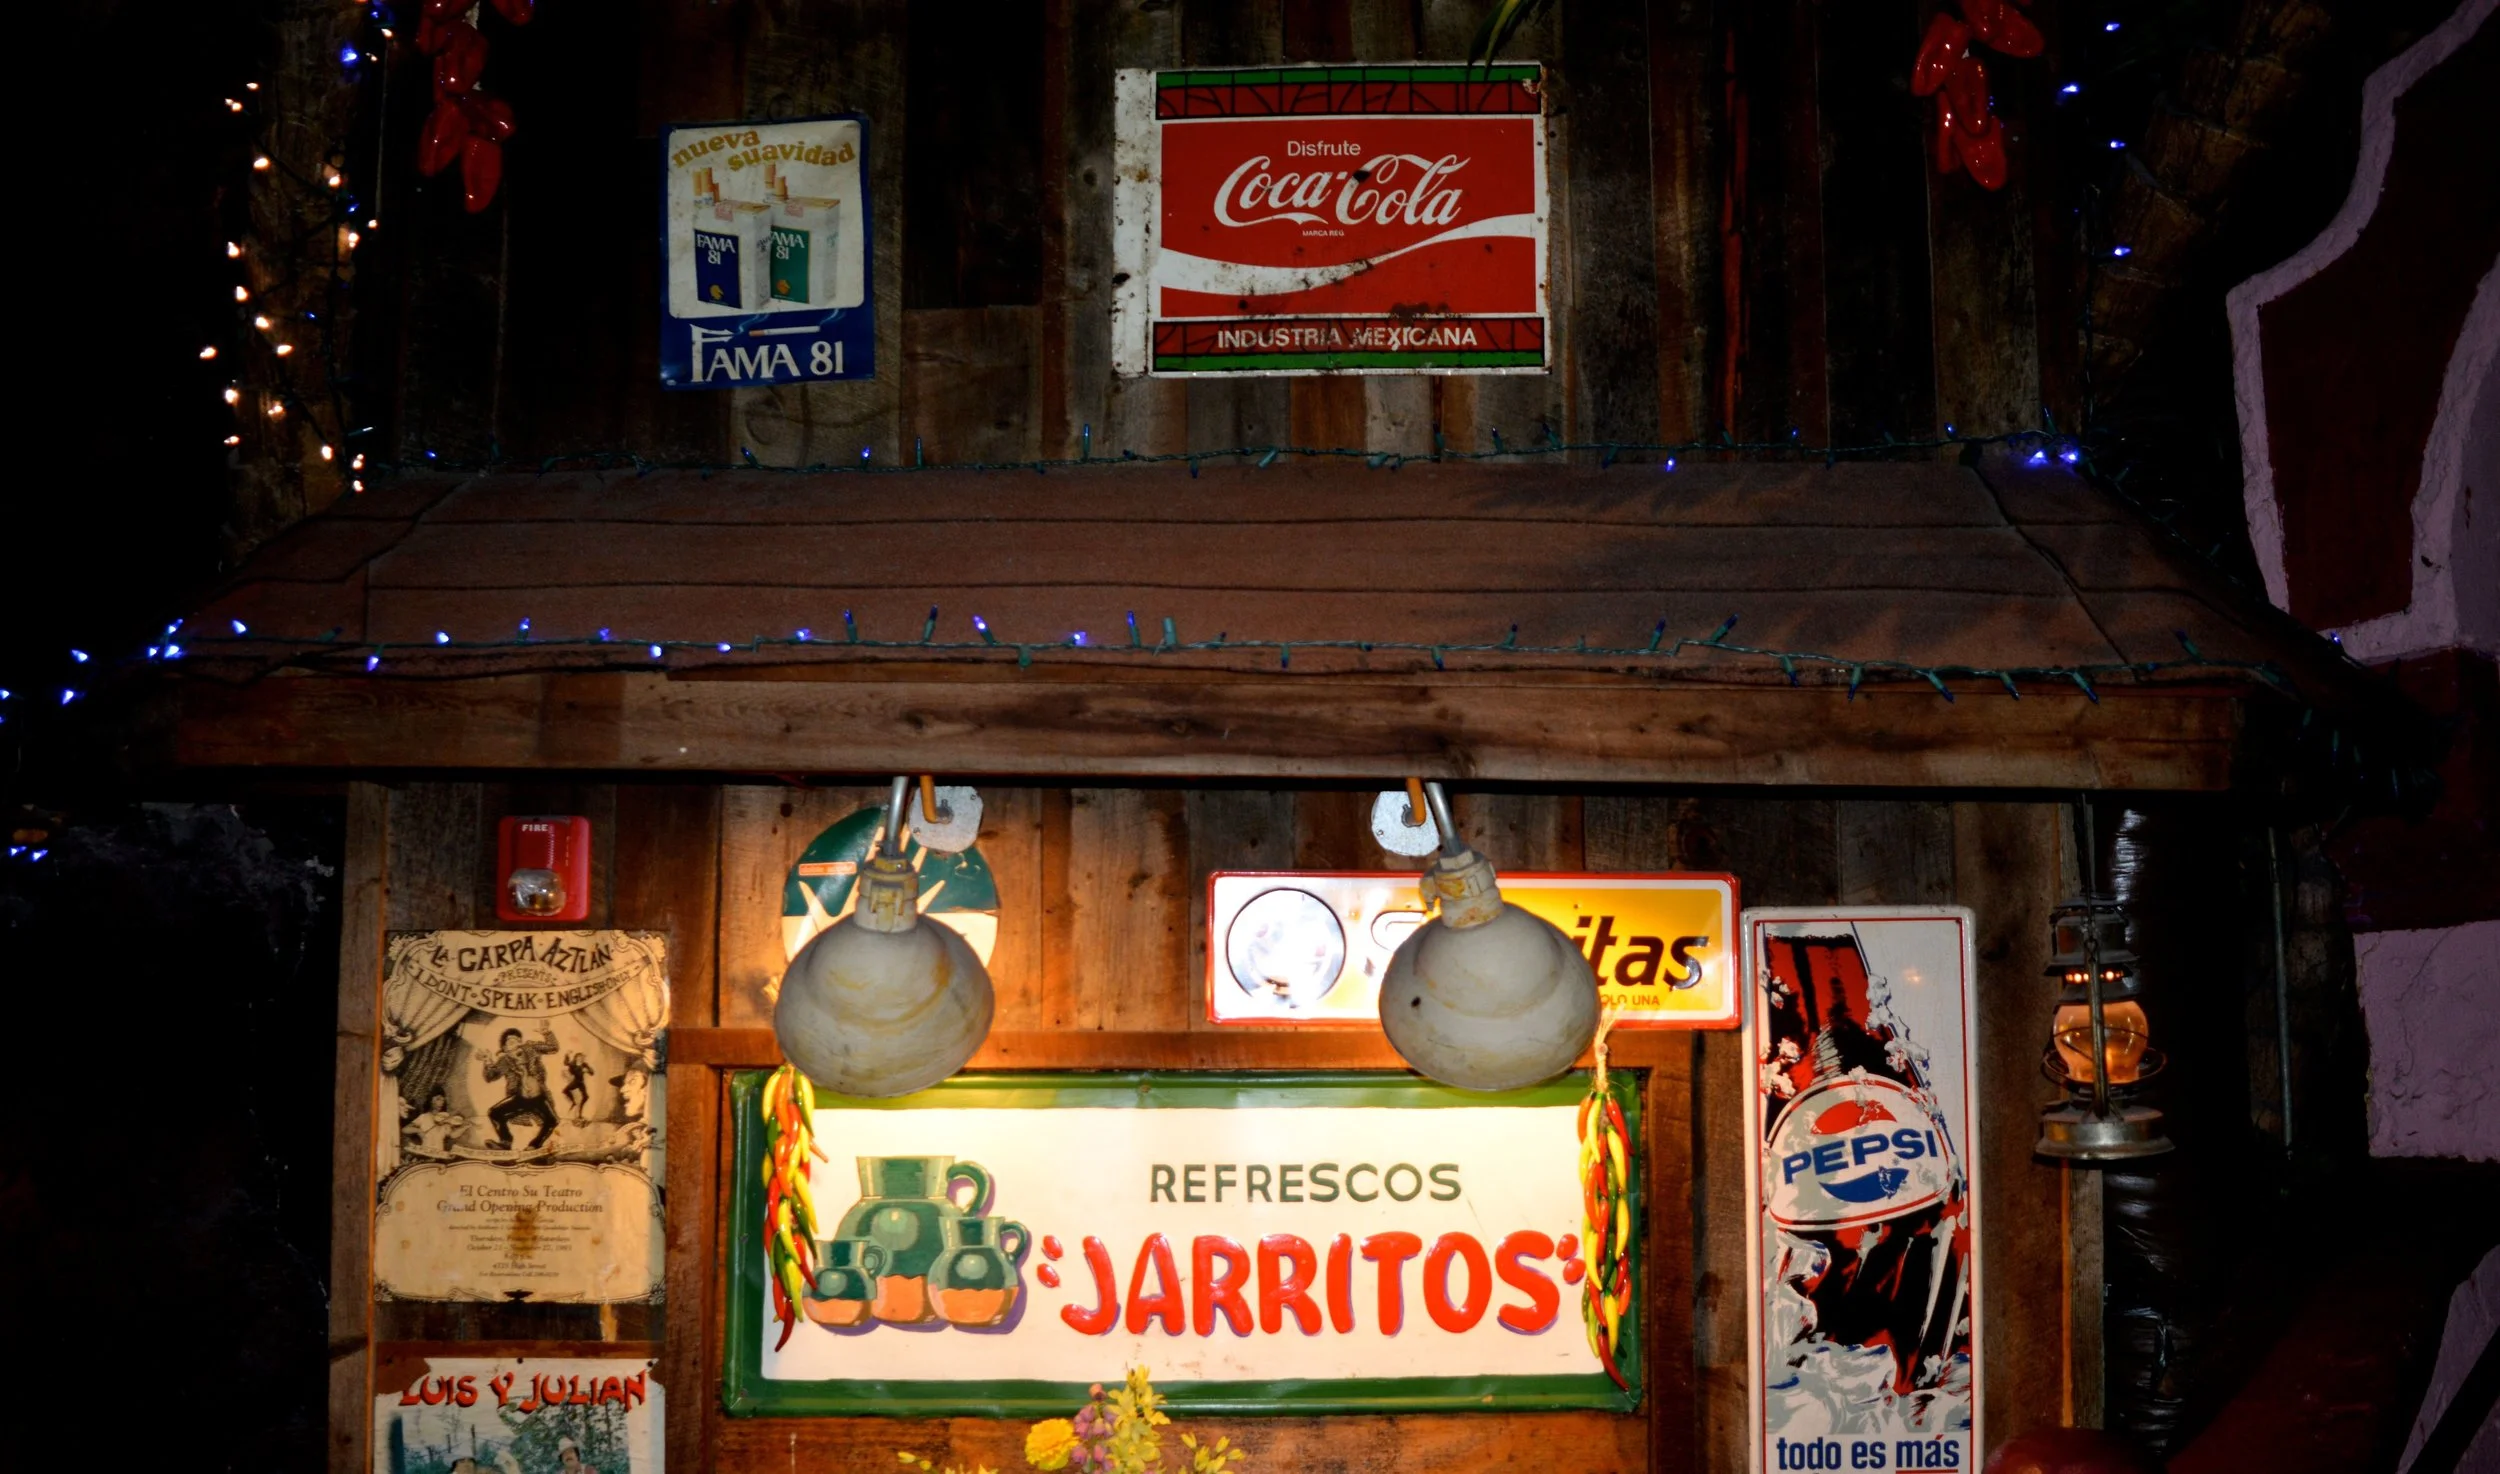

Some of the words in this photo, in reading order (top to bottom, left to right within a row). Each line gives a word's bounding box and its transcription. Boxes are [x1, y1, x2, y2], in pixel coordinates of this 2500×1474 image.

[672, 129, 760, 169] nueva
[727, 141, 856, 172] suavidad
[1287, 140, 1361, 156] Disfrute
[1213, 153, 1471, 227] Coca-Cola
[696, 234, 736, 254] FAMA
[770, 231, 805, 249] AMA
[689, 323, 801, 382] FAMA
[809, 341, 844, 376] 81
[1217, 328, 1342, 348] INDUSTRIA
[1352, 327, 1478, 350] MEXICANA
[521, 824, 549, 832] FIRE
[430, 944, 451, 967] LA
[457, 936, 537, 972] CARPA
[499, 966, 552, 983] PRESENTS
[1632, 994, 1660, 1006] UNA
[1783, 1128, 1938, 1185] PEPSI
[459, 1185, 473, 1197] El
[477, 1185, 519, 1198] Centro
[523, 1185, 539, 1197] Su
[543, 1185, 583, 1197] Teatro
[1149, 1162, 1462, 1204] REFRESCOS
[480, 1200, 532, 1215] Opening
[536, 1200, 603, 1213] Production
[1060, 1230, 1561, 1336] JARRITOS
[398, 1375, 478, 1408] LUIS
[487, 1372, 514, 1409] Y
[518, 1369, 647, 1414] JULIAN
[1777, 1437, 1842, 1470] todo
[1851, 1441, 1886, 1470] es
[1896, 1434, 1960, 1468] más
